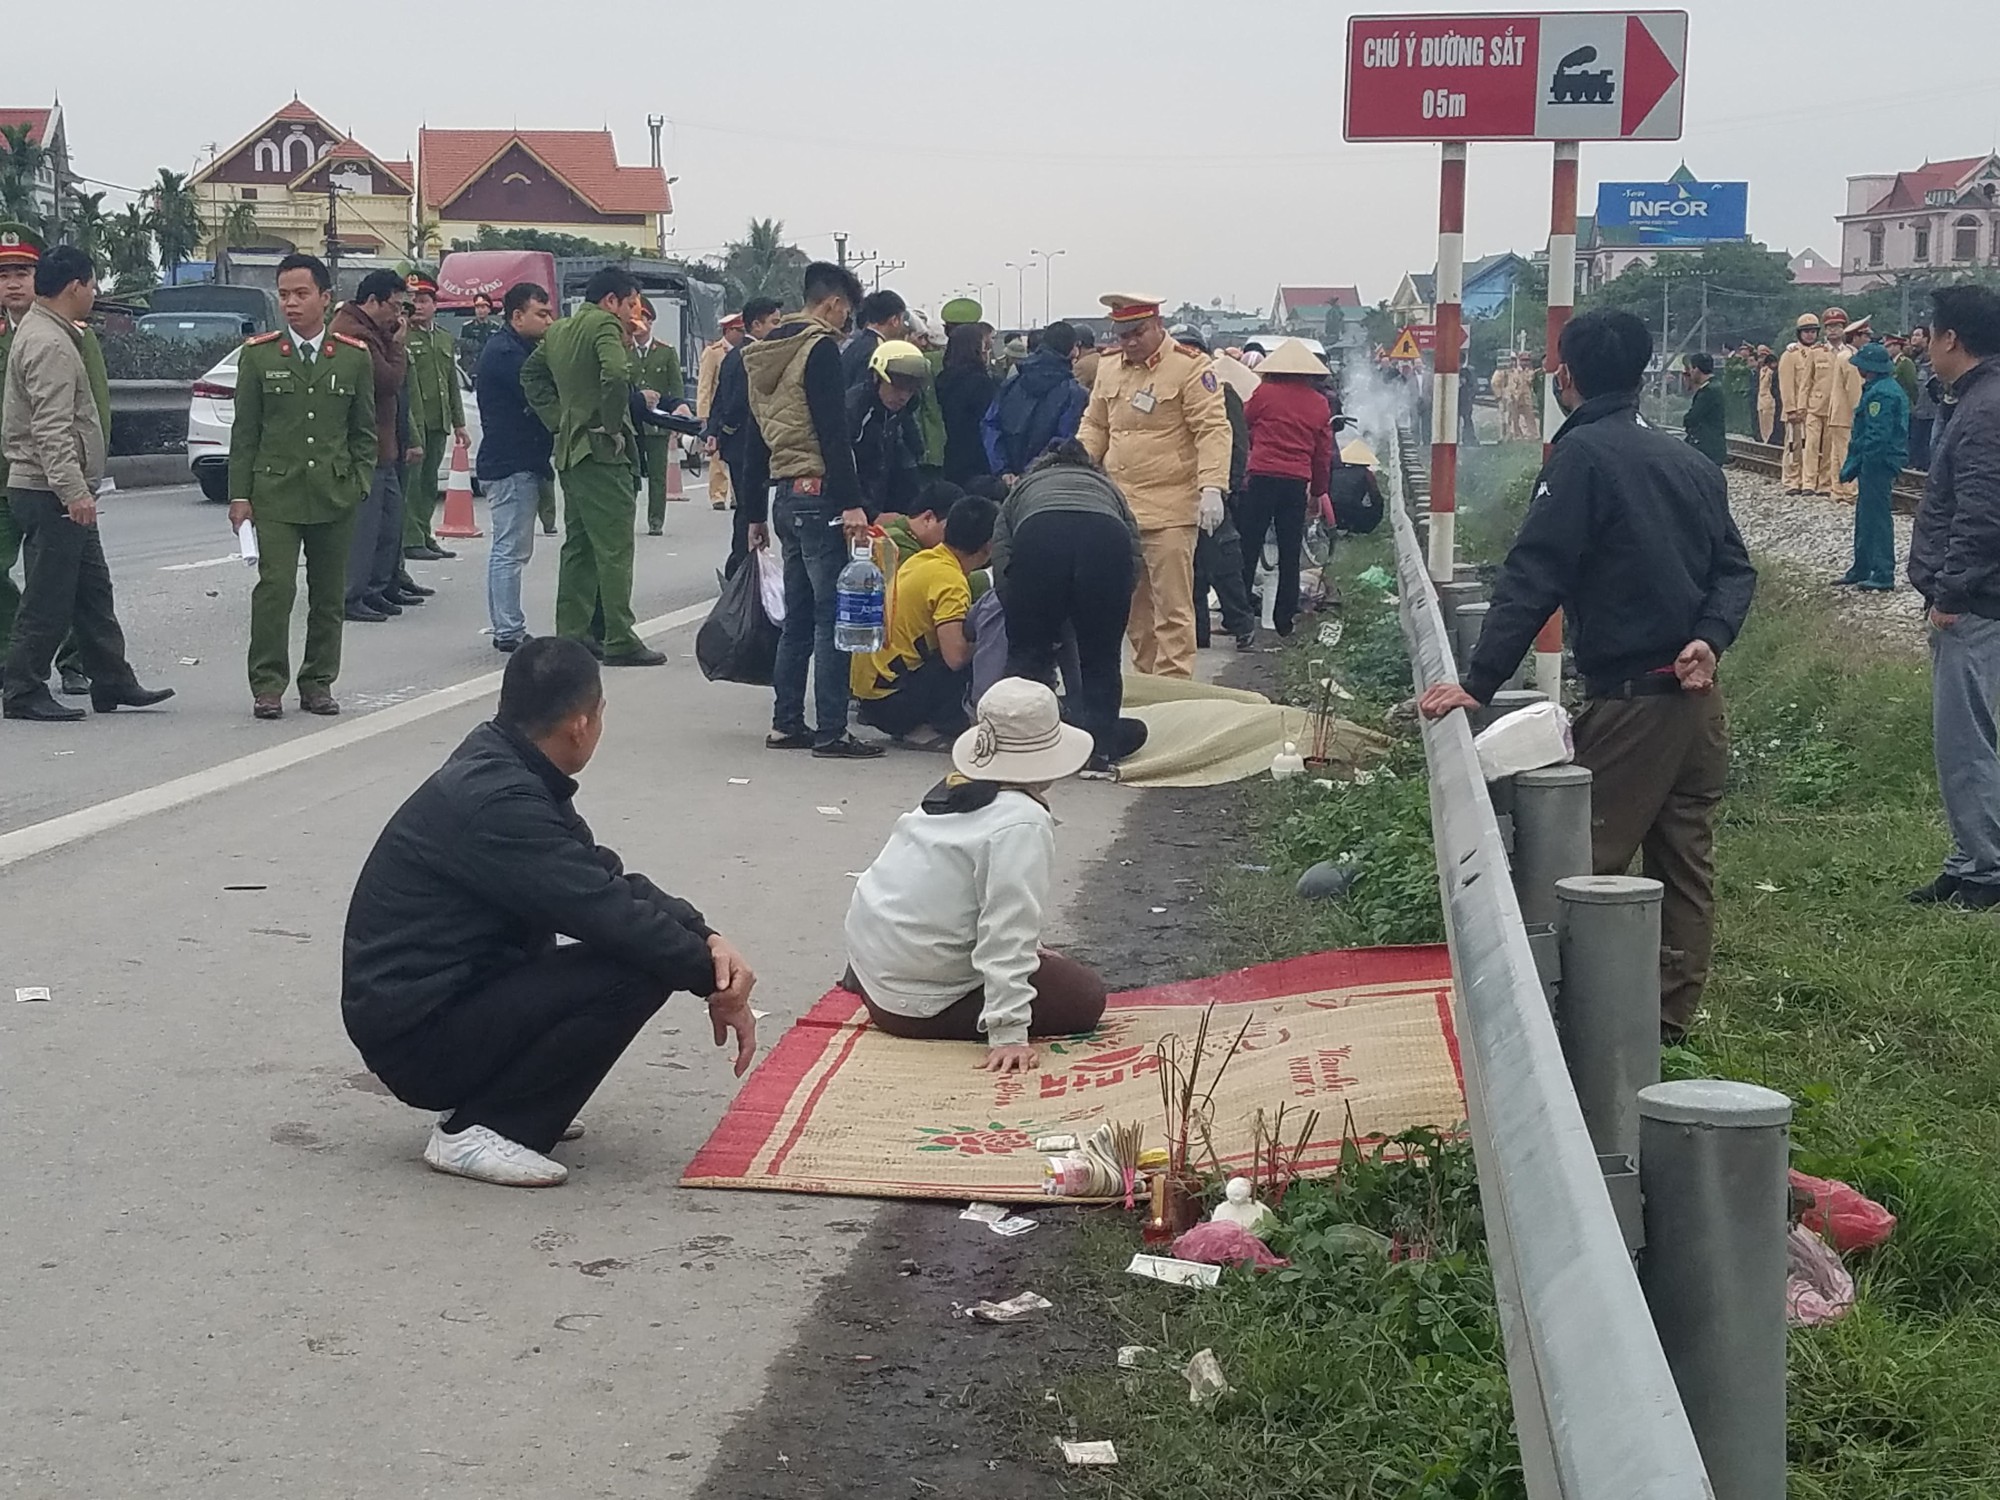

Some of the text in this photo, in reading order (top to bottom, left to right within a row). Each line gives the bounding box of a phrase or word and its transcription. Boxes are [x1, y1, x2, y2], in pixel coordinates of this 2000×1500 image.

[1363, 25, 1526, 68] CHÚ Ý ĐƯỜNG SẮT
[1422, 88, 1467, 119] 05m
[1629, 200, 1708, 217] INFOR
